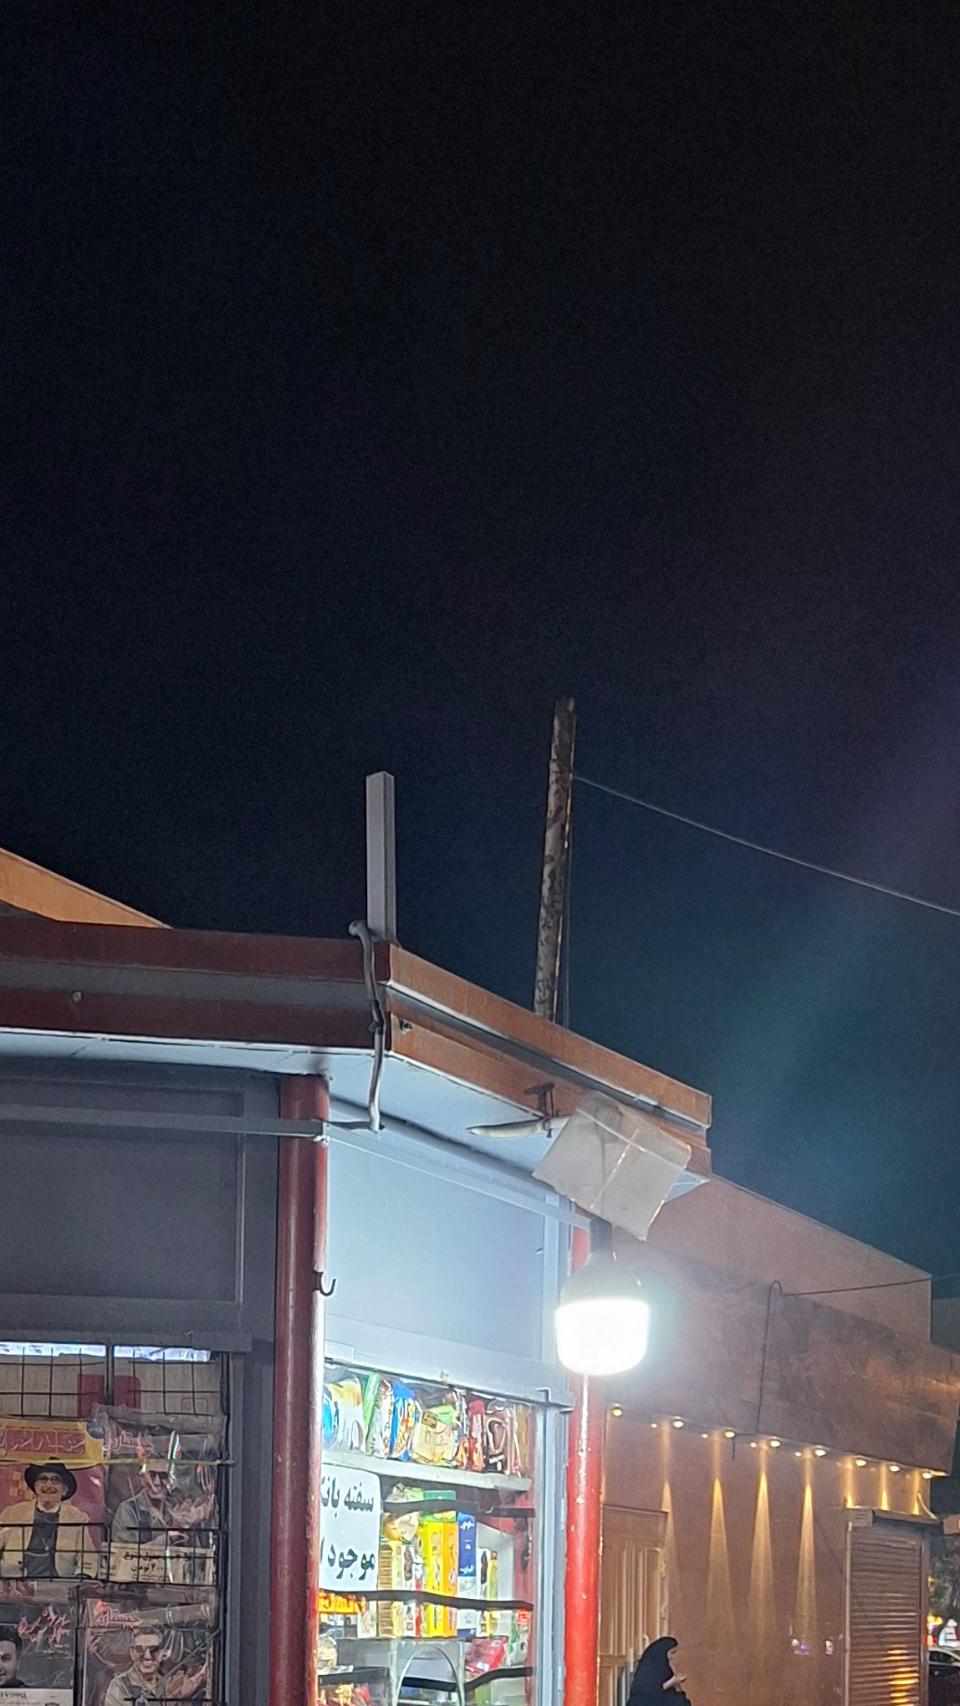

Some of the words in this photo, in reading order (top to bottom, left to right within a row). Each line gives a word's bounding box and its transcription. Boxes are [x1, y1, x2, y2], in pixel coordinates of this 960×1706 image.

[321, 1476, 340, 1517] بان
[344, 1482, 374, 1512] سفته
[328, 1544, 375, 1580] موجود
